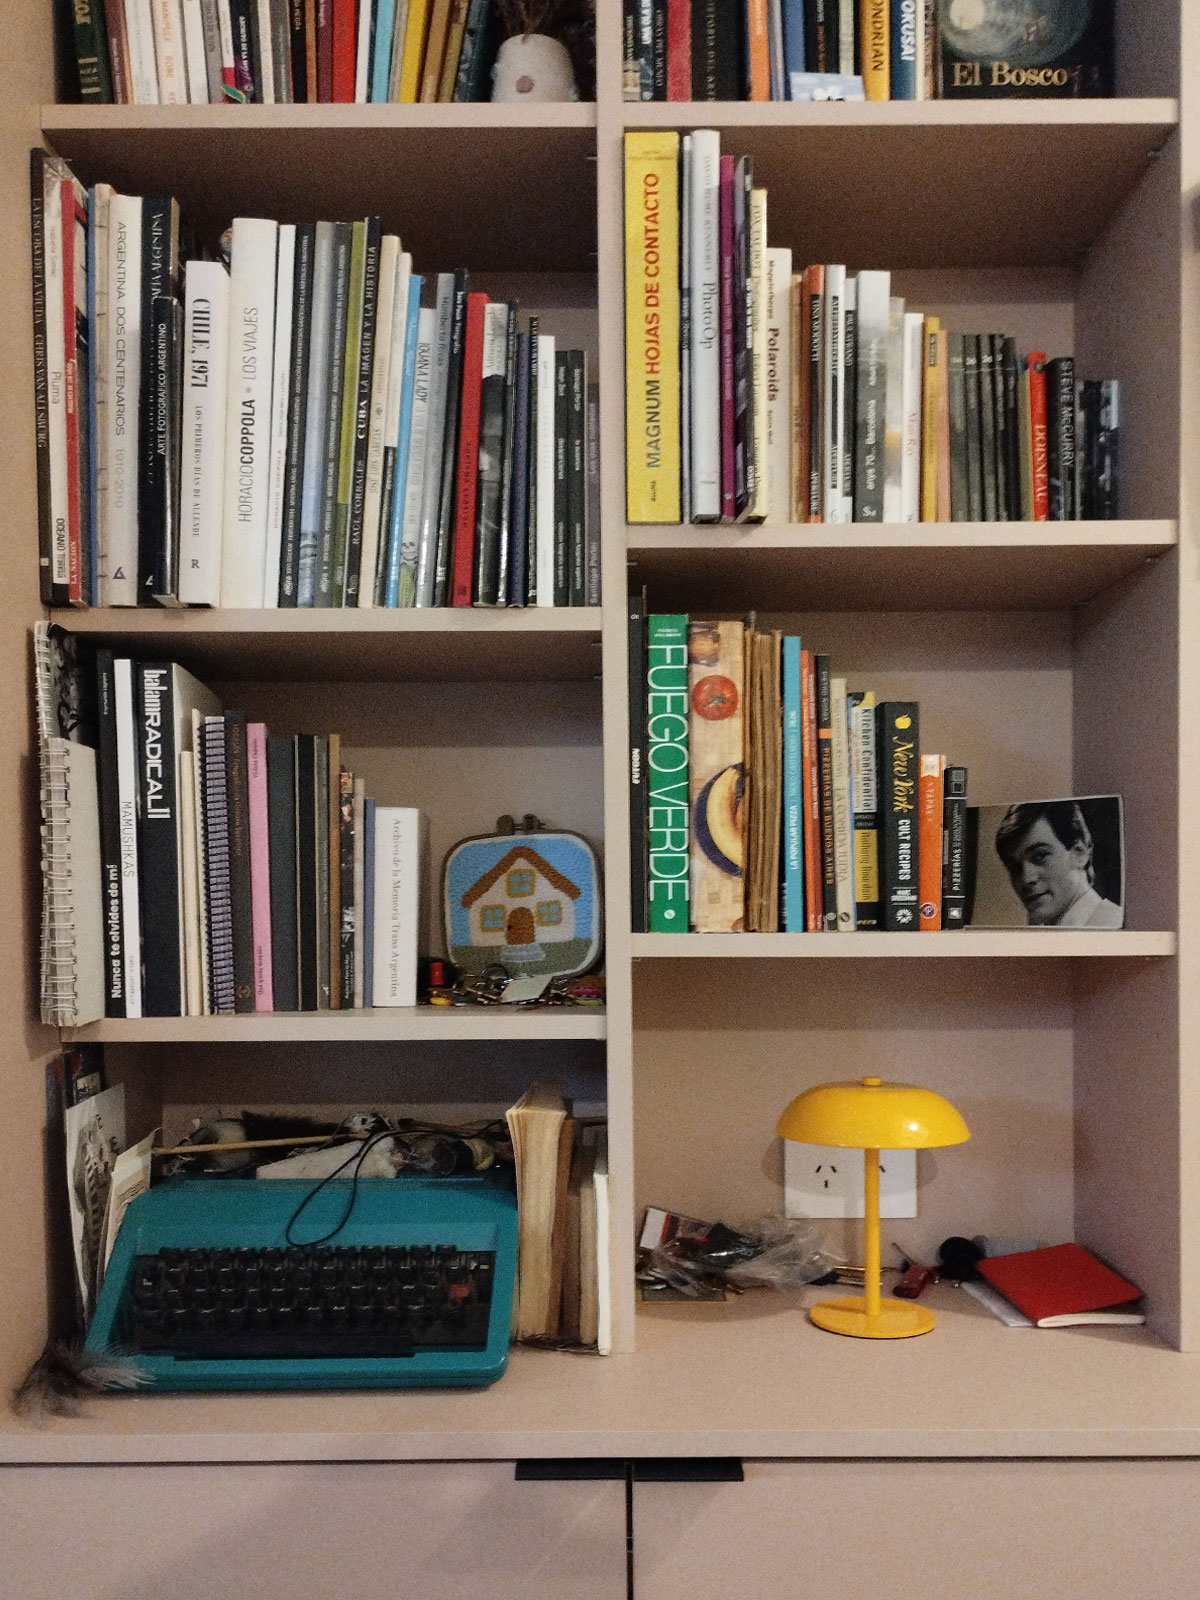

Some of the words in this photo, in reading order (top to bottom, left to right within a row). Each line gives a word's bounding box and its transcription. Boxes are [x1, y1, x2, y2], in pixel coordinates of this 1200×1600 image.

[952, 61, 982, 87] El
[989, 61, 1069, 87] Bosco
[31, 210, 44, 255] ESCOBA
[643, 171, 659, 278] CONTACTO
[32, 255, 43, 272] DE
[364, 244, 377, 298] HISTORIA
[32, 289, 45, 325] VIUDA
[363, 301, 373, 316] LA
[643, 281, 659, 308] DE
[766, 260, 775, 320] Mapplethorpe
[115, 305, 126, 335] DOS
[241, 305, 259, 353] VIAJES
[363, 319, 372, 327] Y
[438, 296, 450, 343] Humberto
[34, 333, 46, 369] CHRIS
[156, 321, 168, 371] ARGENTINO
[359, 330, 372, 374] IMAGEN
[644, 311, 660, 375] HOJAS
[35, 368, 46, 391] VAN
[189, 358, 209, 389] 1971
[241, 355, 257, 380] LOS
[767, 327, 779, 402] Polaroids
[1059, 359, 1073, 402] STEVE
[114, 338, 126, 436] CENTENARIOS
[156, 372, 168, 431] FOTOGRAFICO
[358, 378, 368, 393] LA
[414, 378, 429, 403] LADY
[194, 404, 204, 421] LOS
[356, 398, 367, 439] CUBA
[644, 378, 660, 469] MAGNUM
[865, 398, 875, 445] Barcelona
[907, 411, 917, 434] Man
[157, 431, 167, 455] ARTE
[192, 422, 203, 465] PRIMEROS
[1060, 405, 1074, 469] McCURRY
[114, 445, 125, 509] 1910-2010
[866, 467, 875, 489] anys
[1033, 423, 1048, 503] DOISNEAU
[192, 488, 201, 500] DE
[352, 459, 364, 514] CORRALES
[54, 516, 66, 551] OCEANO
[190, 502, 200, 538] ALLENDE
[350, 515, 361, 544] RAÚL
[70, 573, 77, 585] LA
[589, 567, 598, 604] Santiago
[647, 643, 689, 773] FUEGO
[860, 707, 873, 747] Kitchen
[891, 735, 914, 777] New
[834, 787, 847, 803] LA
[860, 749, 874, 812] Confidential
[892, 777, 915, 813] York
[788, 803, 797, 827] PIZZA
[823, 798, 832, 812] DE
[119, 800, 135, 878] MAMUSHKAS
[391, 817, 401, 856] Archivo
[647, 779, 689, 902] VERDE
[788, 826, 798, 860] POPULAR
[823, 814, 833, 854] BUENOS
[834, 803, 848, 849] COMIDA
[897, 818, 911, 841] CULT
[391, 856, 401, 868] de
[391, 868, 401, 877] la
[789, 860, 798, 870] LA
[824, 855, 834, 886] AIRES
[897, 842, 912, 881] RECIPES
[106, 878, 119, 897] de
[390, 879, 401, 921] Memoria
[107, 896, 120, 942] olvides
[390, 923, 400, 950] Trans
[109, 941, 121, 956] te
[109, 957, 122, 998] Nunca
[388, 950, 400, 998] Argentina
